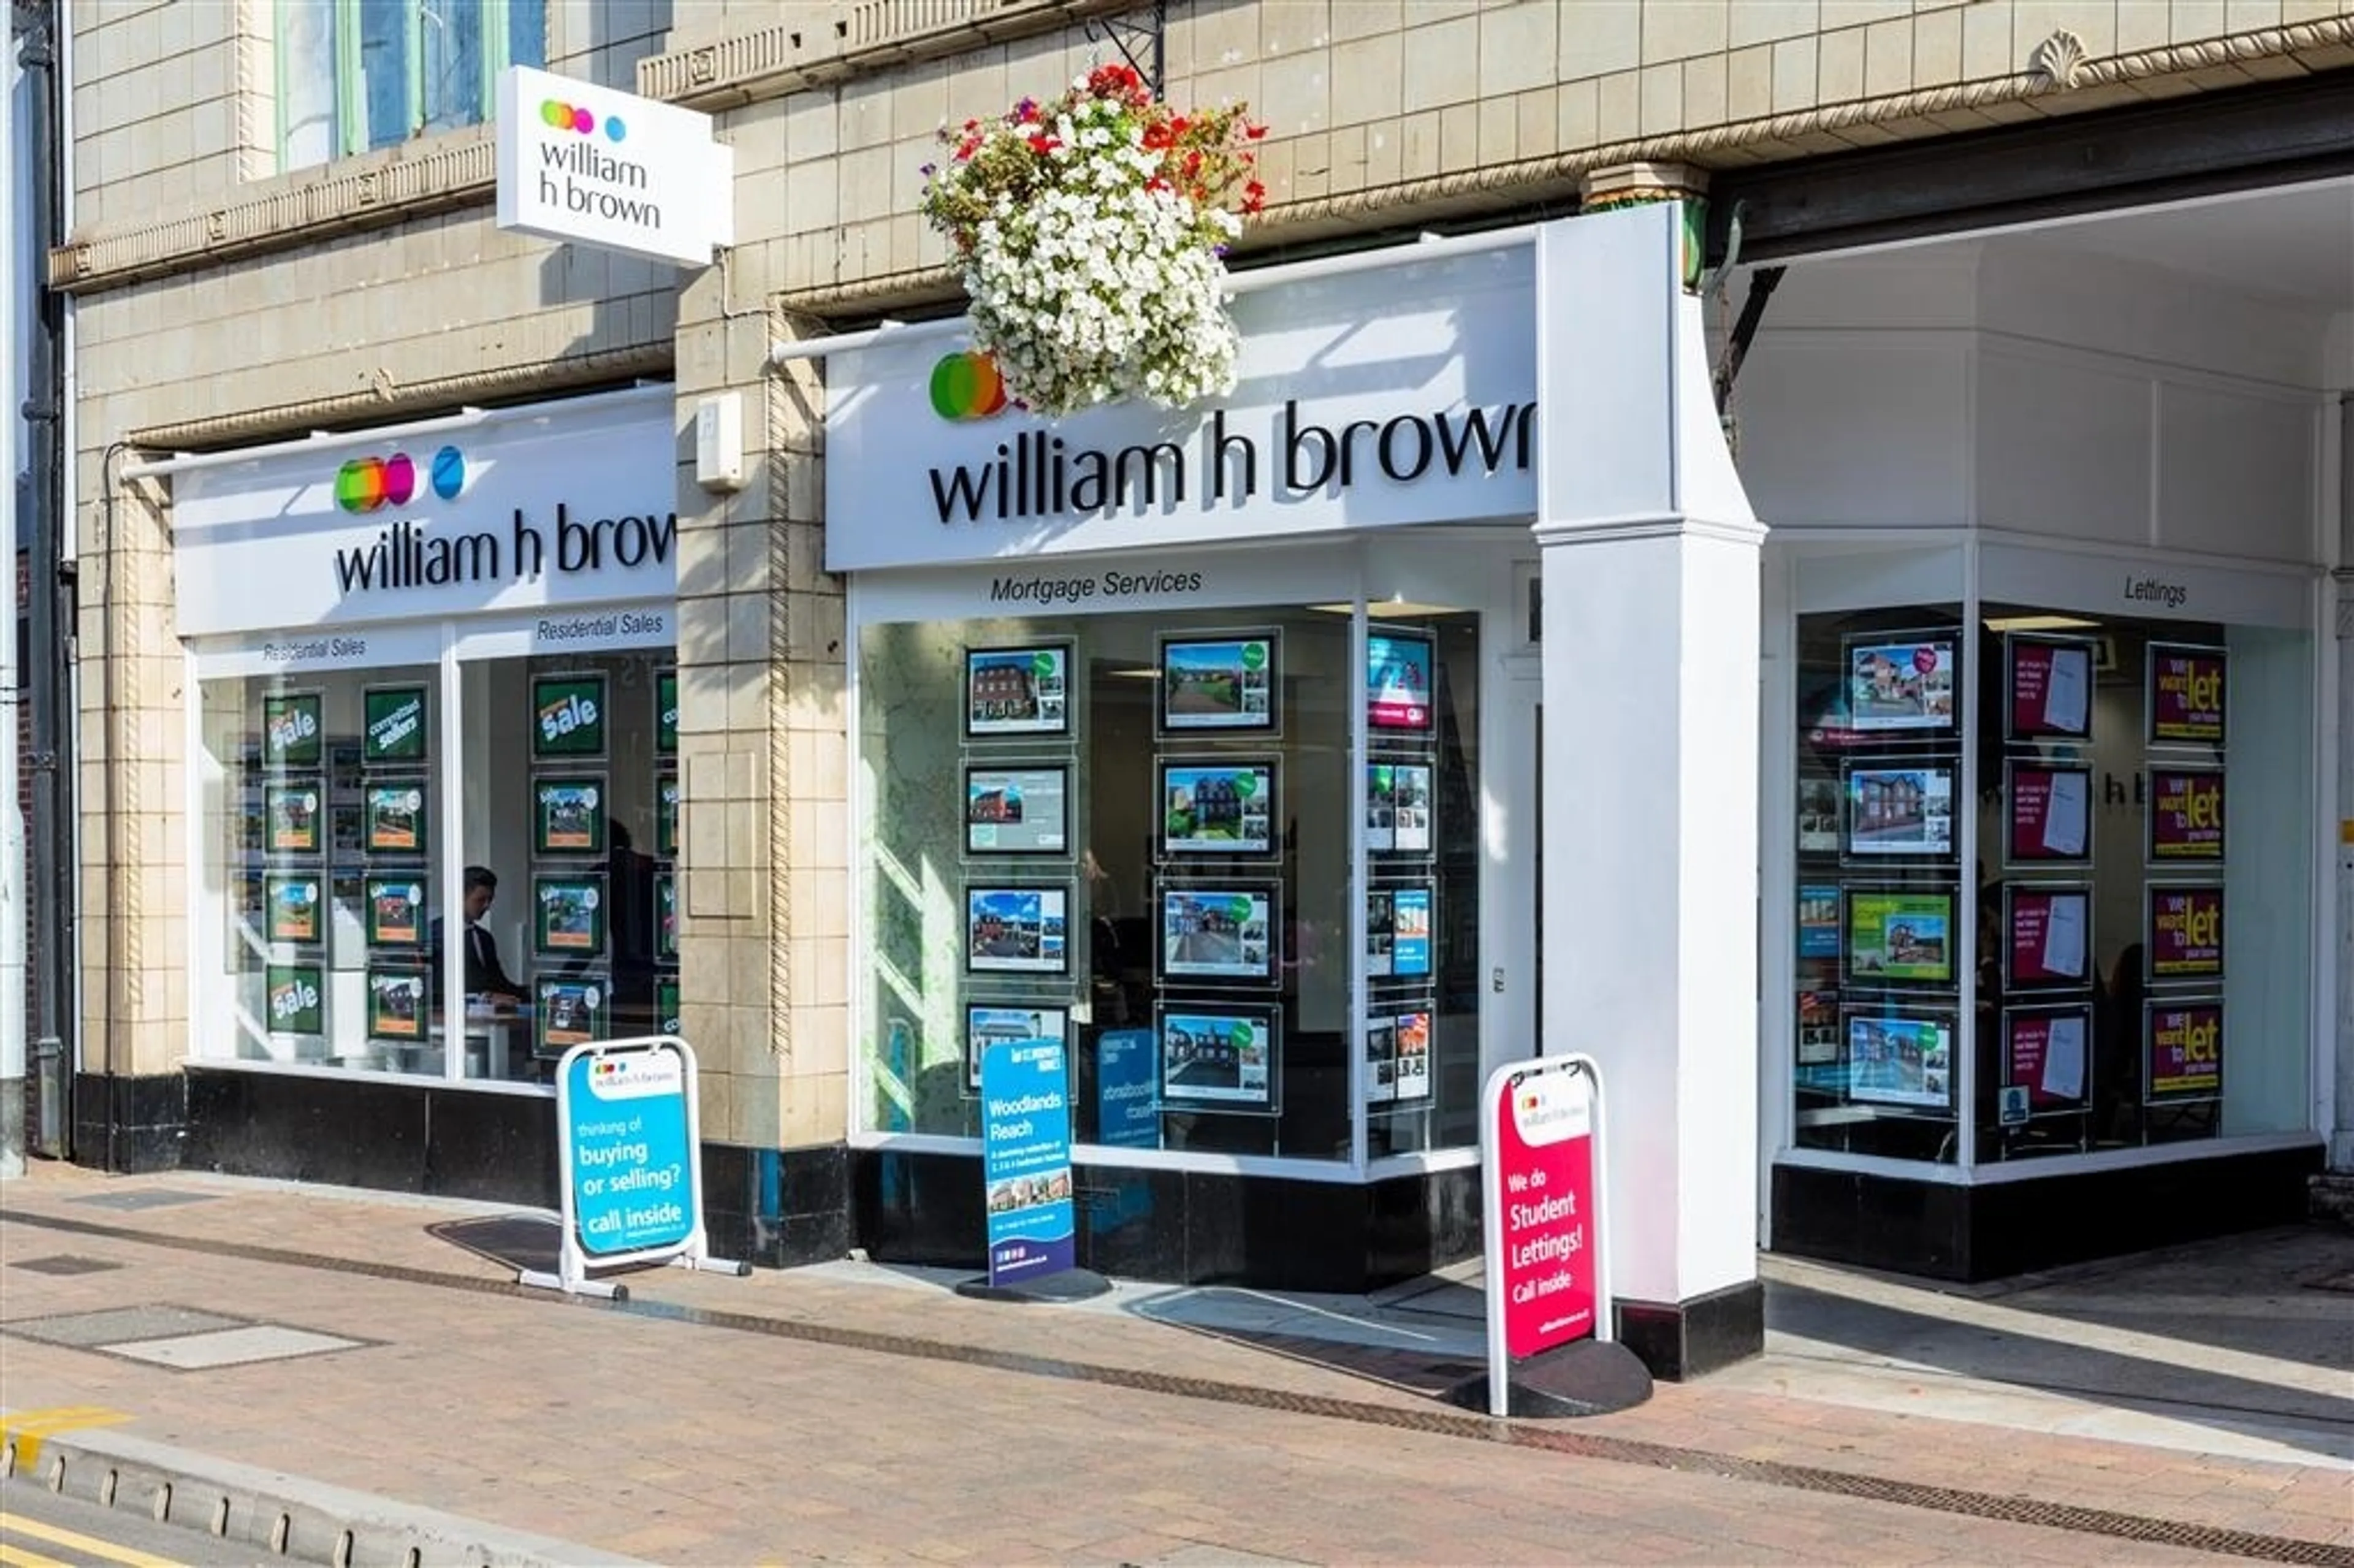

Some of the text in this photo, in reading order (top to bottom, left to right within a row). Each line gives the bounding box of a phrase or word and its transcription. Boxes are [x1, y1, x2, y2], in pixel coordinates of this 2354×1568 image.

[541, 142, 647, 189] william
[540, 170, 660, 229] h brown
[929, 430, 1184, 523] william
[1214, 409, 1256, 497] h
[337, 503, 677, 592] william h brow
[991, 570, 1202, 604] Mortgage Services
[2124, 577, 2187, 607] Lettings
[332, 637, 367, 657] Sales
[537, 614, 663, 640] Residential Sales
[2188, 660, 2221, 711] let
[270, 709, 316, 752] sale
[541, 694, 598, 742] sale
[2187, 778, 2220, 828] let
[2186, 896, 2219, 946] let
[273, 979, 318, 1020] sale
[2185, 1011, 2218, 1061] let
[988, 1091, 1063, 1117] Woodlands
[577, 1116, 642, 1137] thinking of
[990, 1118, 1034, 1141] Reach
[579, 1141, 648, 1168] buying
[583, 1162, 682, 1196] or selling?
[1508, 1168, 1546, 1193] We do
[588, 1208, 622, 1233] call
[625, 1202, 682, 1228] inside
[1510, 1190, 1576, 1231] Student
[1512, 1222, 1583, 1269] Lettings!
[1512, 1269, 1572, 1304] Call inside
